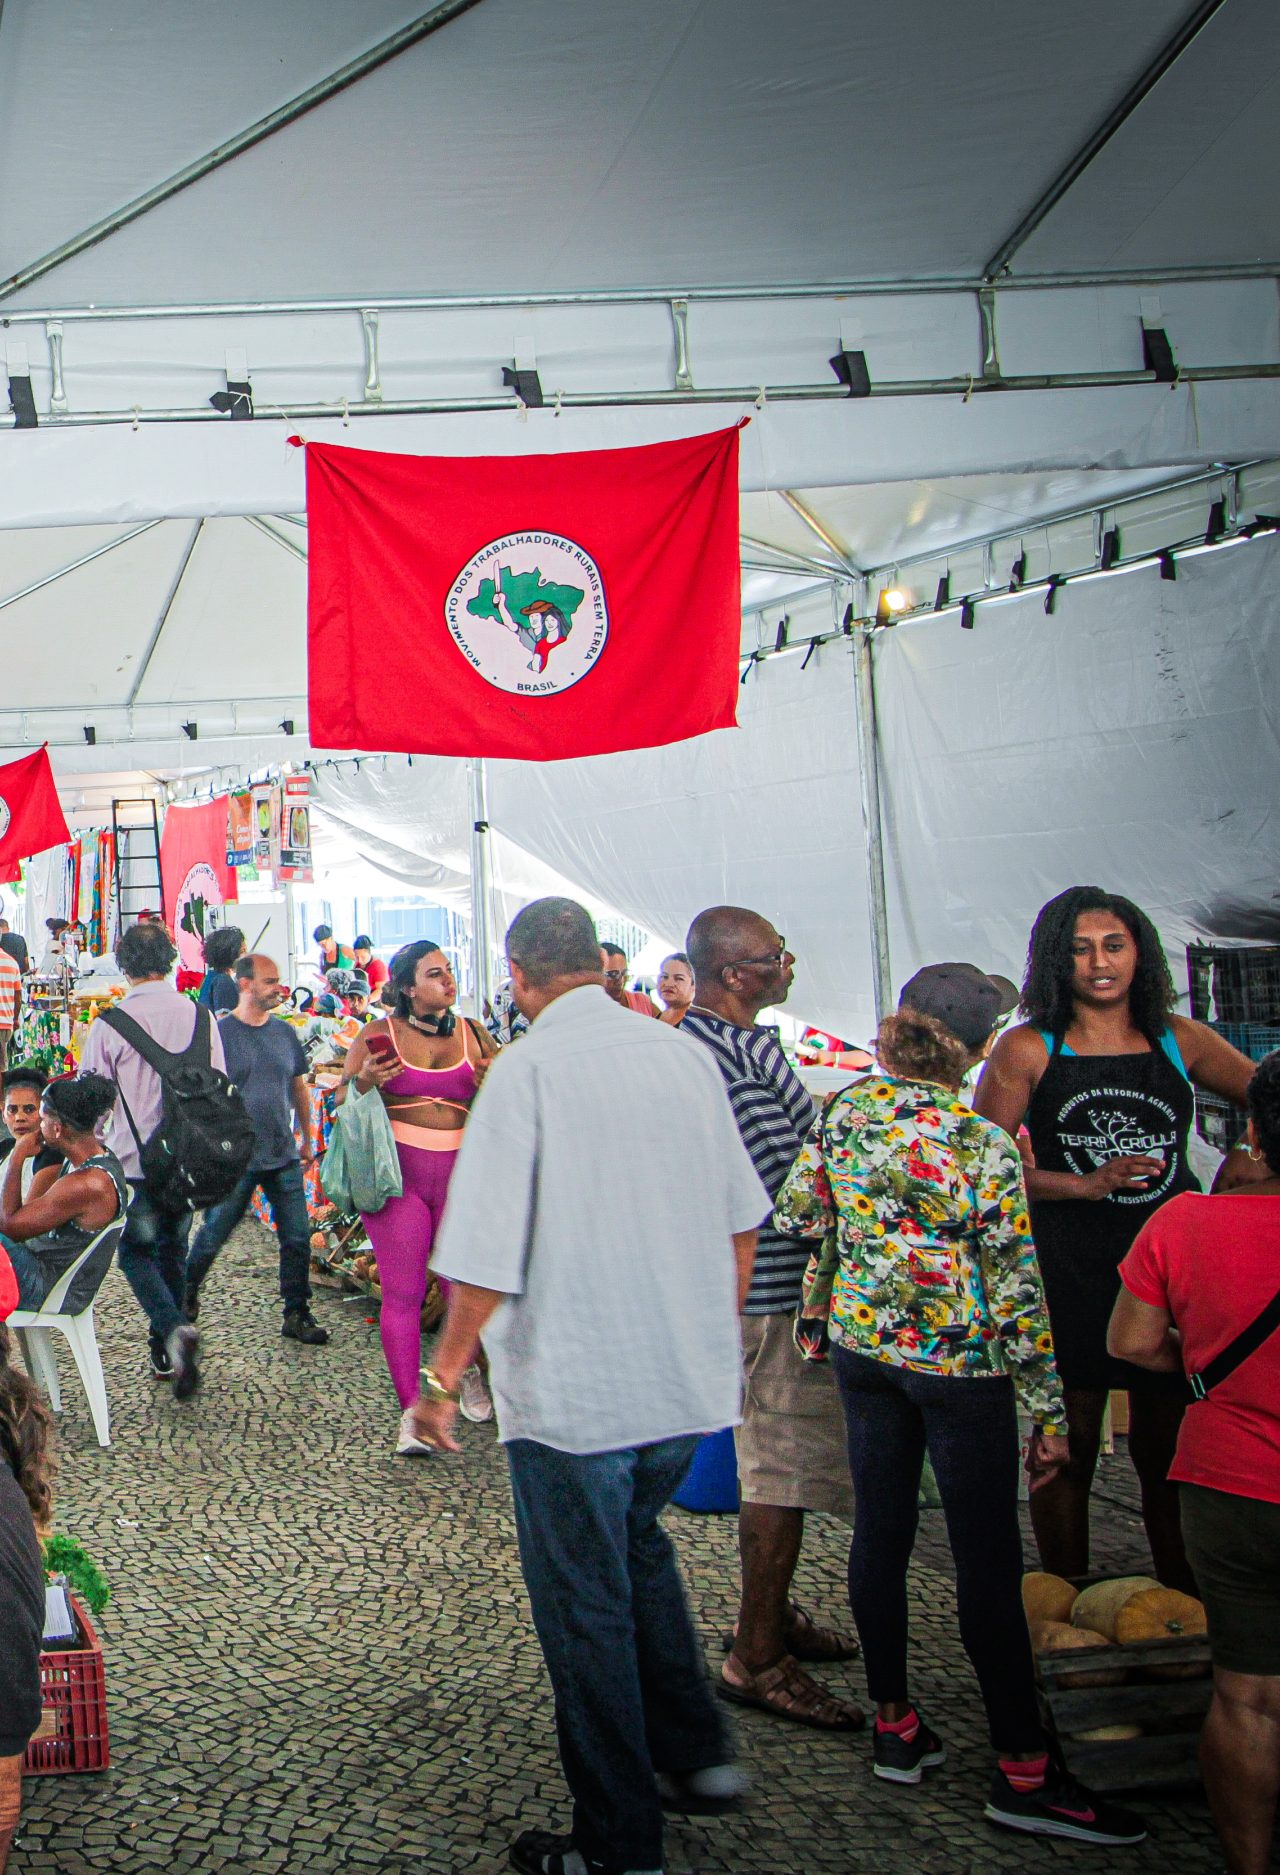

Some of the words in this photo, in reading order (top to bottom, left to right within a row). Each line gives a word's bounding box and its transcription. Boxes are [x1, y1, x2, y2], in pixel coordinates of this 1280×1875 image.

[472, 535, 573, 569] TRABALHADORES
[455, 569, 473, 594] DOS
[573, 551, 600, 592] RURAIS
[593, 594, 603, 620] SEM
[448, 597, 481, 667] MOVIMENTO
[583, 623, 604, 661] TERRA
[517, 680, 558, 691] BRASIL
[1057, 1091, 1090, 1123] PRODUTOS
[1091, 1089, 1102, 1097] DA
[1103, 1088, 1145, 1100] REFORMA
[1147, 1096, 1177, 1122] AGRÁRIA
[1057, 1133, 1107, 1149] TERRA
[1119, 1130, 1177, 1149] CRIOULA
[1117, 1190, 1163, 1204] RESISTÊNCIA
